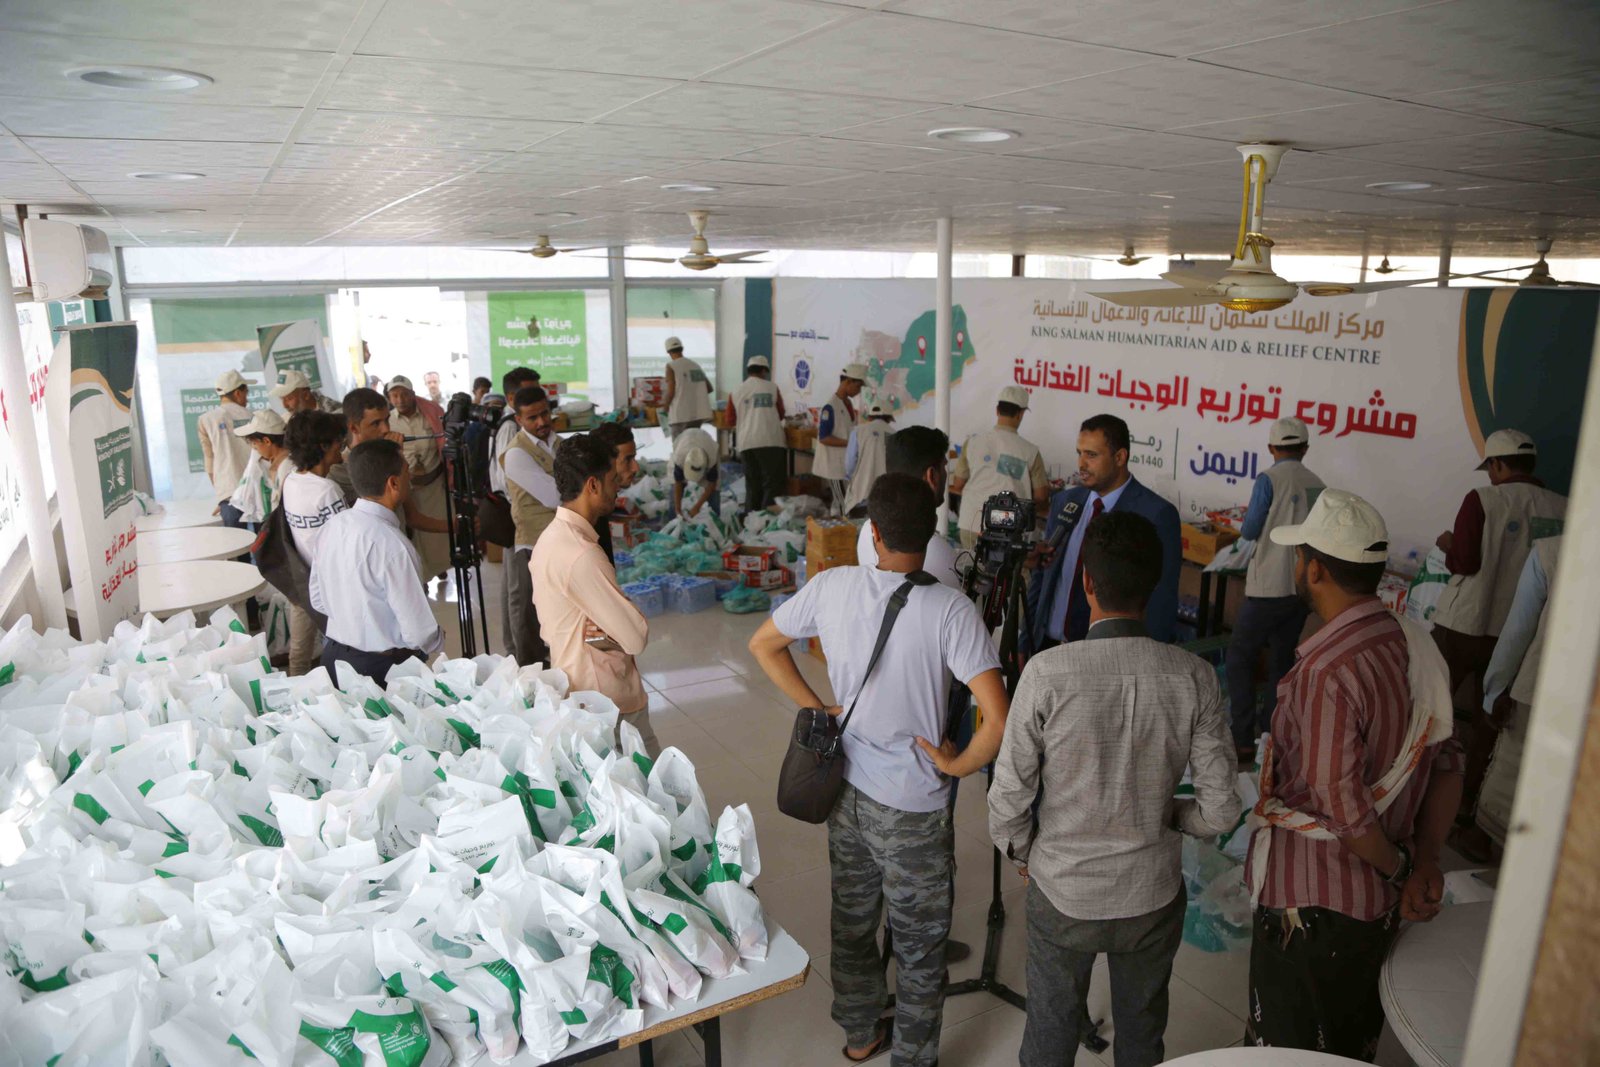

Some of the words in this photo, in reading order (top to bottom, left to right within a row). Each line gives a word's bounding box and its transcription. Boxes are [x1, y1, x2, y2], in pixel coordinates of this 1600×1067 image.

[1033, 299, 1089, 324] الإنسانية
[1209, 306, 1269, 332] سلمان
[1274, 309, 1330, 334] الملك
[1334, 311, 1385, 341] مركز
[1031, 325, 1058, 338] KING
[1060, 327, 1104, 342] SALMAN
[1107, 330, 1207, 350] HUMANITARIAN
[1210, 338, 1238, 354] AID
[1240, 340, 1252, 354] &
[1256, 341, 1309, 359] RELIEF
[1312, 345, 1382, 365] CENTRE
[1013, 357, 1090, 395] الغذائية
[1098, 369, 1190, 411] الوجبات
[1199, 382, 1282, 425] توزيع
[1296, 389, 1418, 440] مشروع
[1189, 444, 1258, 485] اليمن
